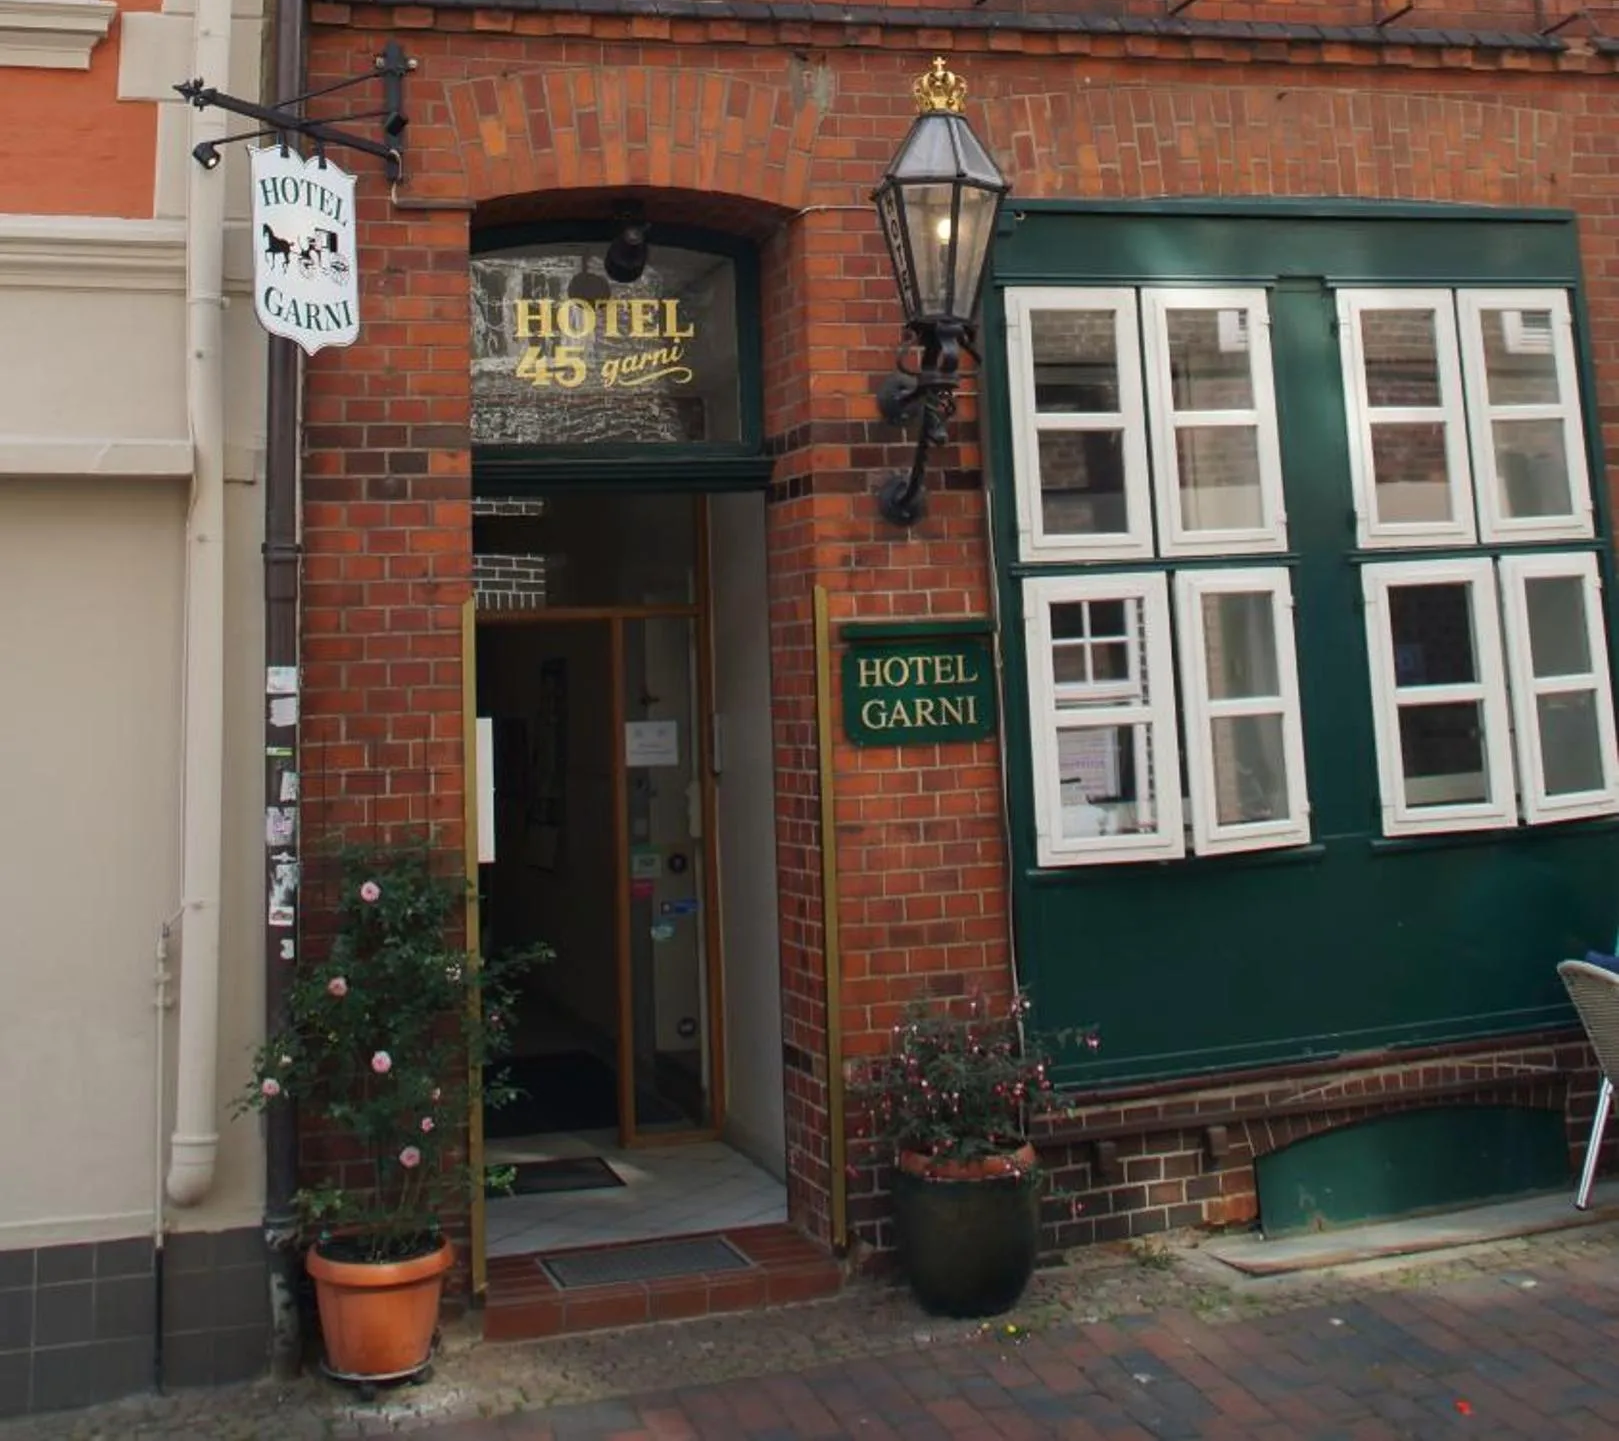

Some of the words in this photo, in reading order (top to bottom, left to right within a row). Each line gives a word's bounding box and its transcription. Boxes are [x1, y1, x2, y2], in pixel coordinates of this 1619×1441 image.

[260, 176, 348, 226] HOTEL
[264, 286, 353, 331] GARNI
[514, 298, 694, 338] HOTEL
[515, 345, 587, 388] 45
[600, 339, 692, 388] garni
[858, 654, 979, 688] HOTEL
[861, 696, 978, 730] GARNI
